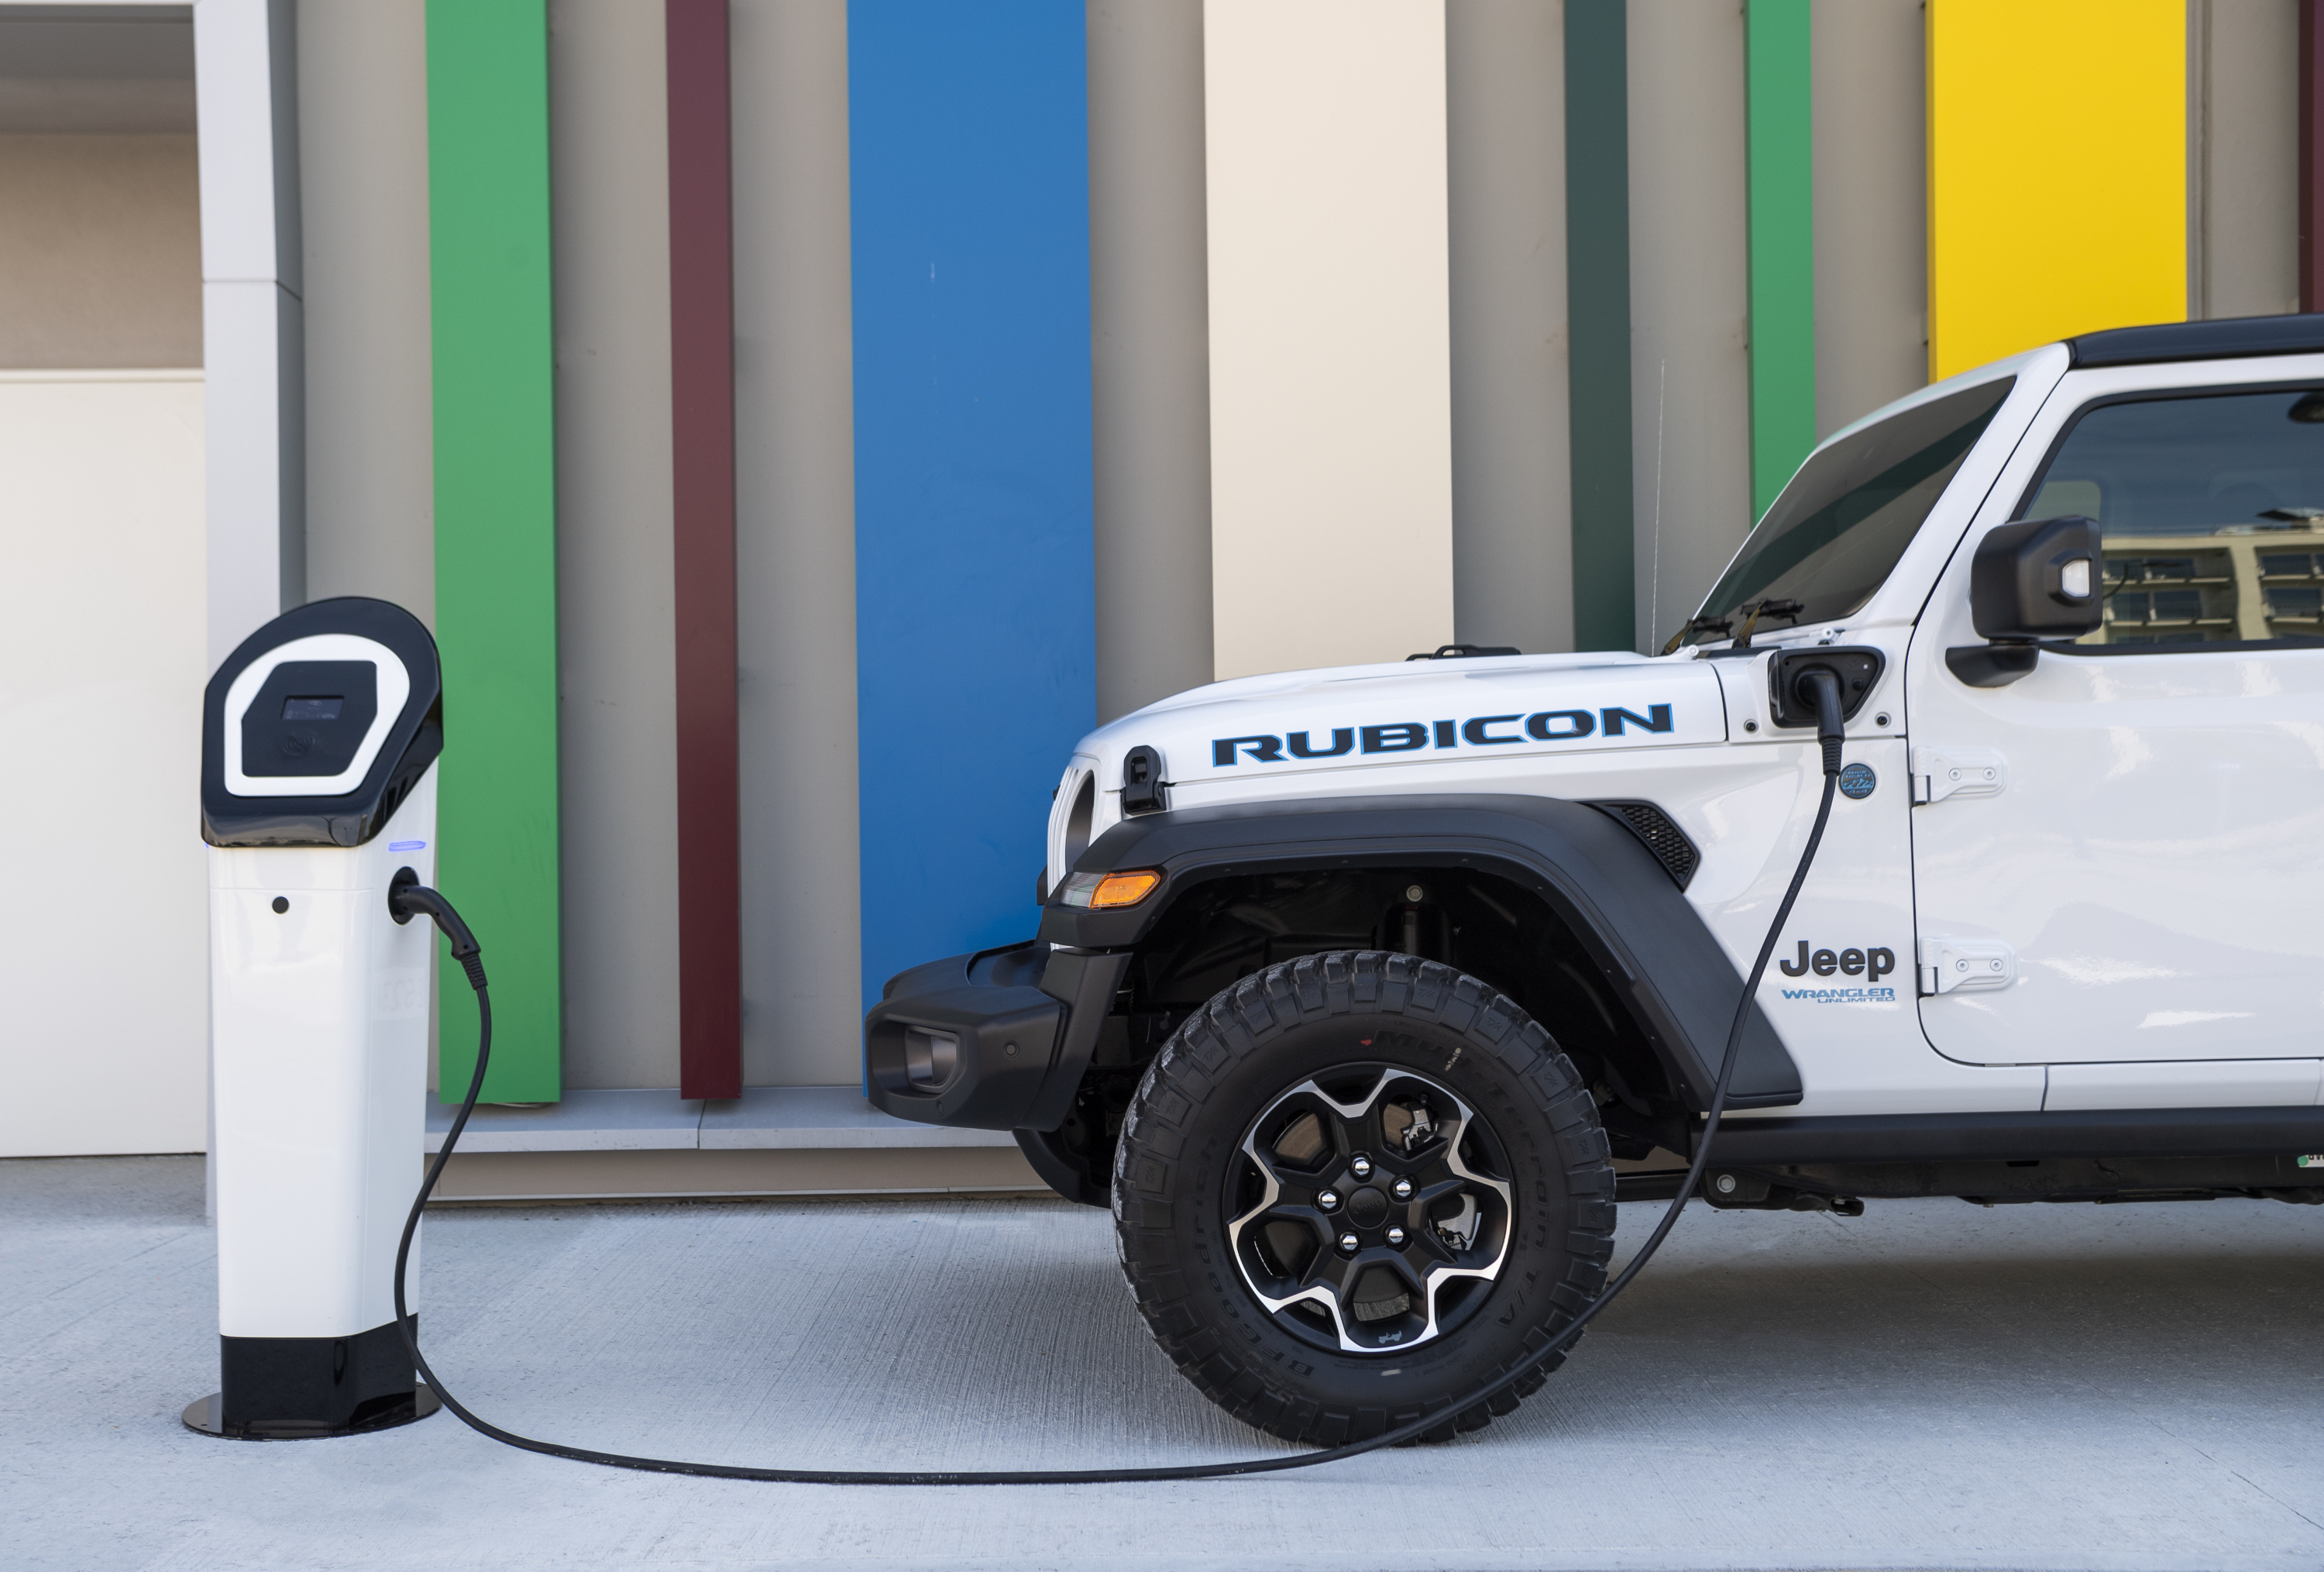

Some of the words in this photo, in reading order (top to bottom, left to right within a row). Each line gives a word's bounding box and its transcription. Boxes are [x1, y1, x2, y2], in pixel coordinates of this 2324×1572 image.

[1212, 703, 1675, 768] RUBICON
[1779, 940, 1895, 982] Jeep
[1781, 988, 1895, 999] WRANGLER
[1484, 1015, 1503, 1032] T/A
[1202, 1044, 1220, 1062] T/A
[1542, 1069, 1559, 1089] T/A
[1164, 1097, 1180, 1116] T/A
[1576, 1137, 1590, 1156] T/A
[1353, 1198, 1383, 1215] Jeep
[1193, 1134, 1315, 1379] BFGoodrich
[1495, 1267, 1542, 1328] T/A
